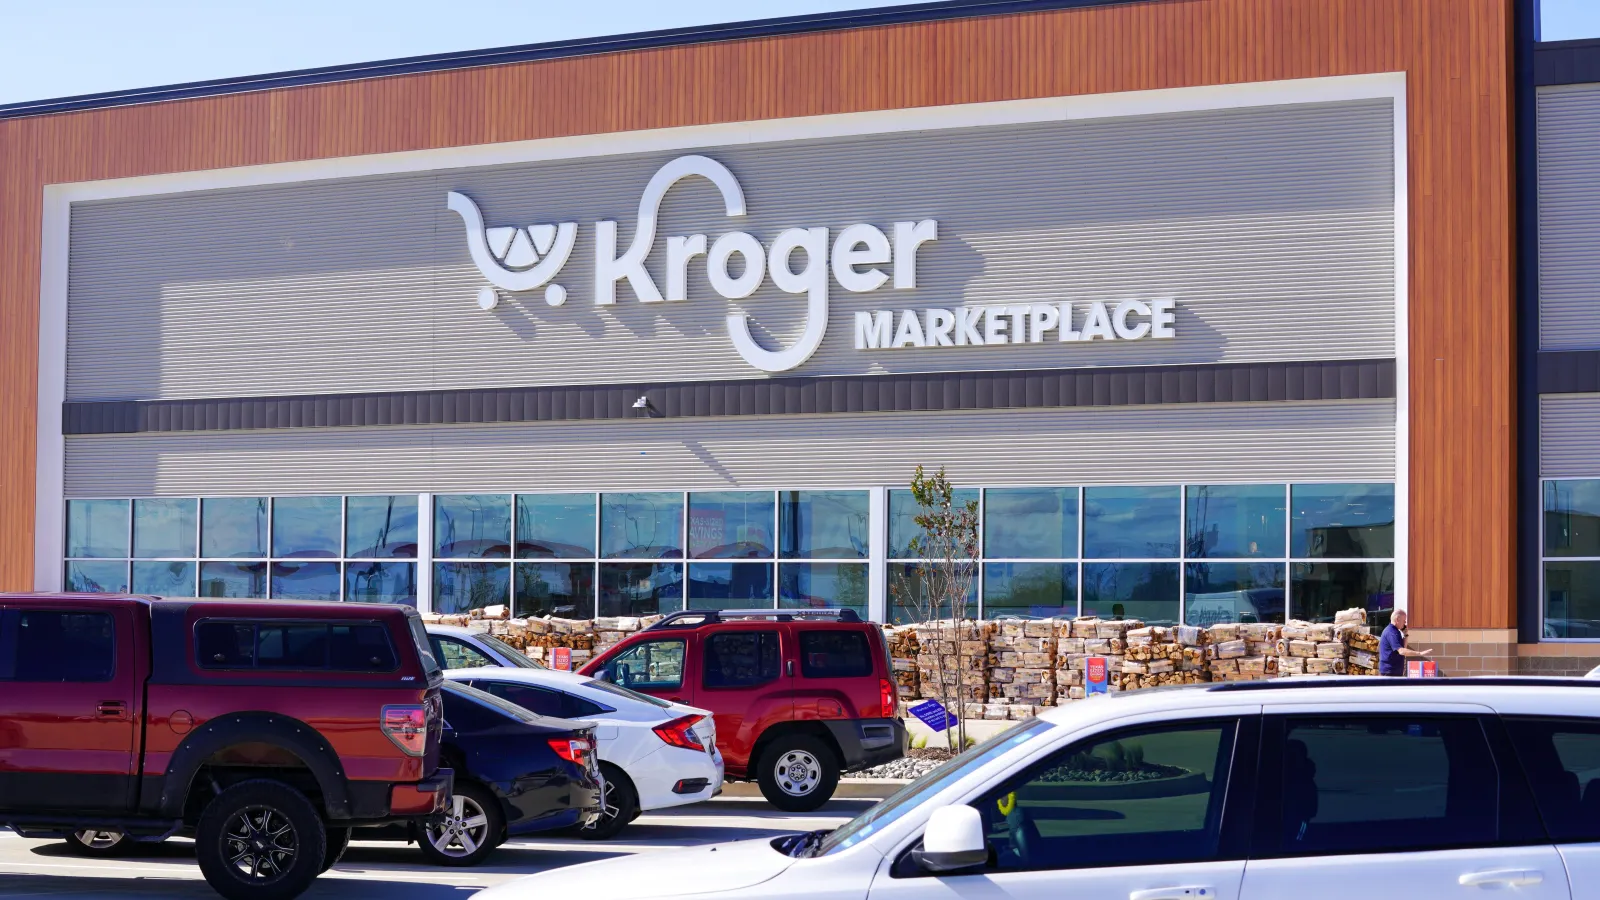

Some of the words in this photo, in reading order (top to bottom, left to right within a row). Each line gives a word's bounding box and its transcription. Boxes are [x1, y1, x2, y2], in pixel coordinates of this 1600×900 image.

[595, 154, 938, 372] Kroger
[854, 298, 1177, 350] MARKETPLACE
[689, 516, 723, 527] XAS-SIZED
[689, 526, 723, 540] AVINGS
